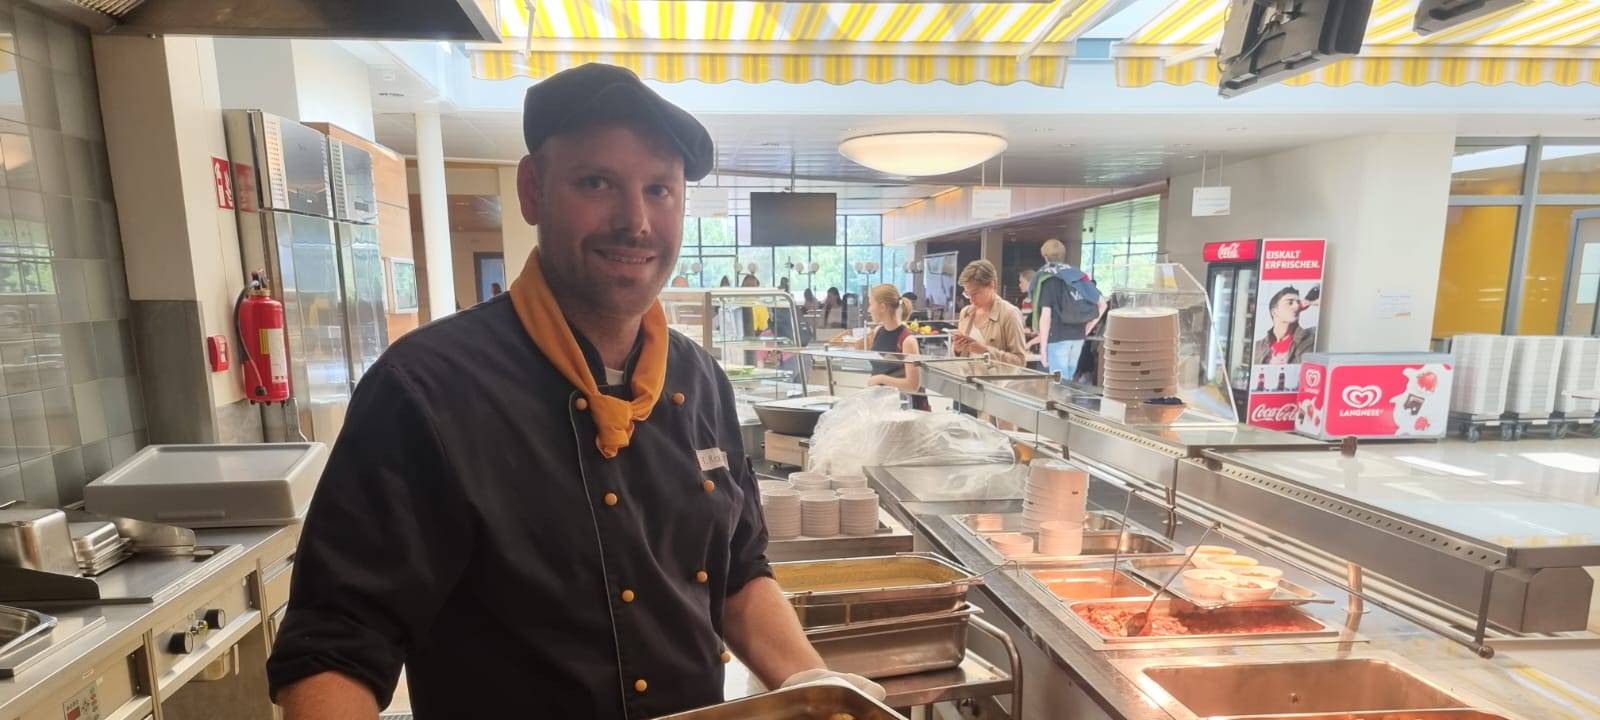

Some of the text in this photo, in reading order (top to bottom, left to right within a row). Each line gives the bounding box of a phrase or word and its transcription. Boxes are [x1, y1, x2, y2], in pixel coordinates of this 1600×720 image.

[1266, 250, 1301, 260] EISKALT
[1265, 260, 1320, 270] ERFRISCHEN.
[1339, 409, 1381, 417] LANGNESE
